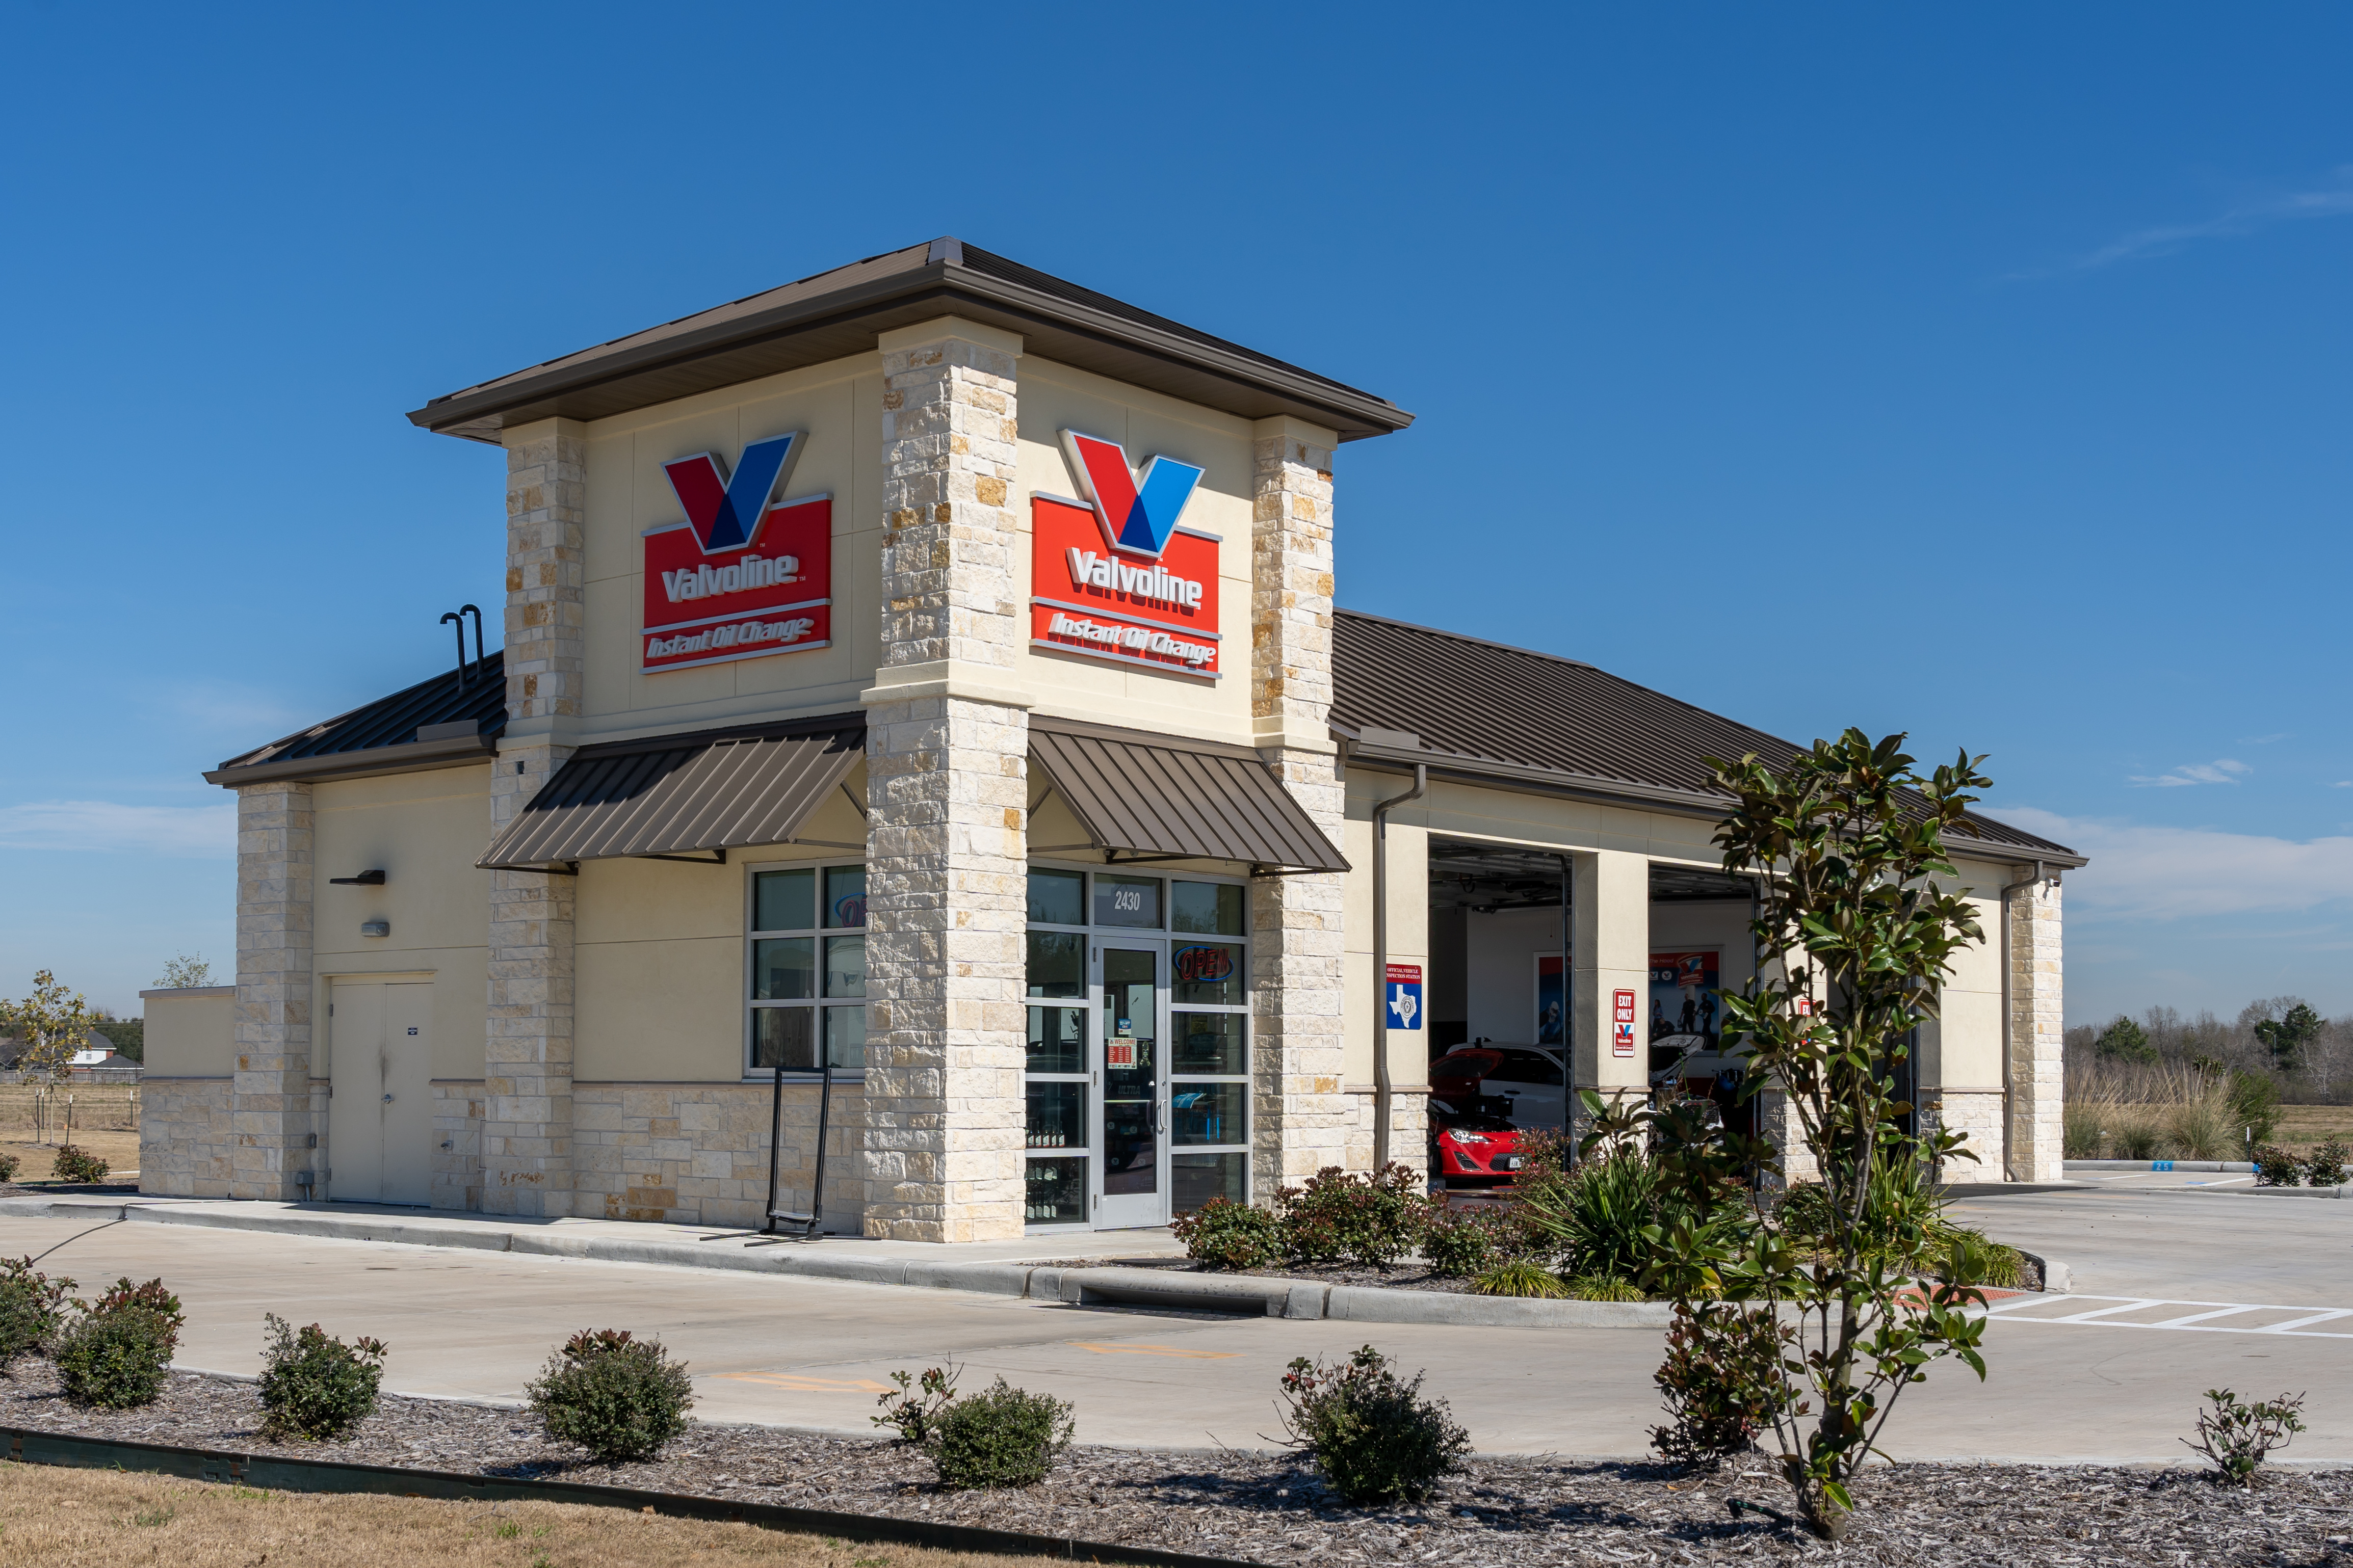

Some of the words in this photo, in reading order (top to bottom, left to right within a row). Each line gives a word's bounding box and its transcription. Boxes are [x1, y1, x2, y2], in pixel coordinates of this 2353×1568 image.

[662, 554, 799, 602] Valvoline
[1065, 547, 1202, 608] Valvoline
[646, 630, 713, 658] Instant
[712, 625, 739, 648] Oil
[738, 618, 815, 644] Change
[1048, 613, 1123, 644] Instant
[1119, 627, 1150, 650] Oil
[1145, 632, 1216, 665] Change
[1114, 891, 1140, 911] 2430
[1181, 948, 1229, 980] OPEN
[1617, 1008, 1633, 1020] ONLY
[1618, 995, 1632, 1007] EXIT
[1802, 1004, 1811, 1015] EXI
[1118, 1085, 1141, 1095] ULTRA
